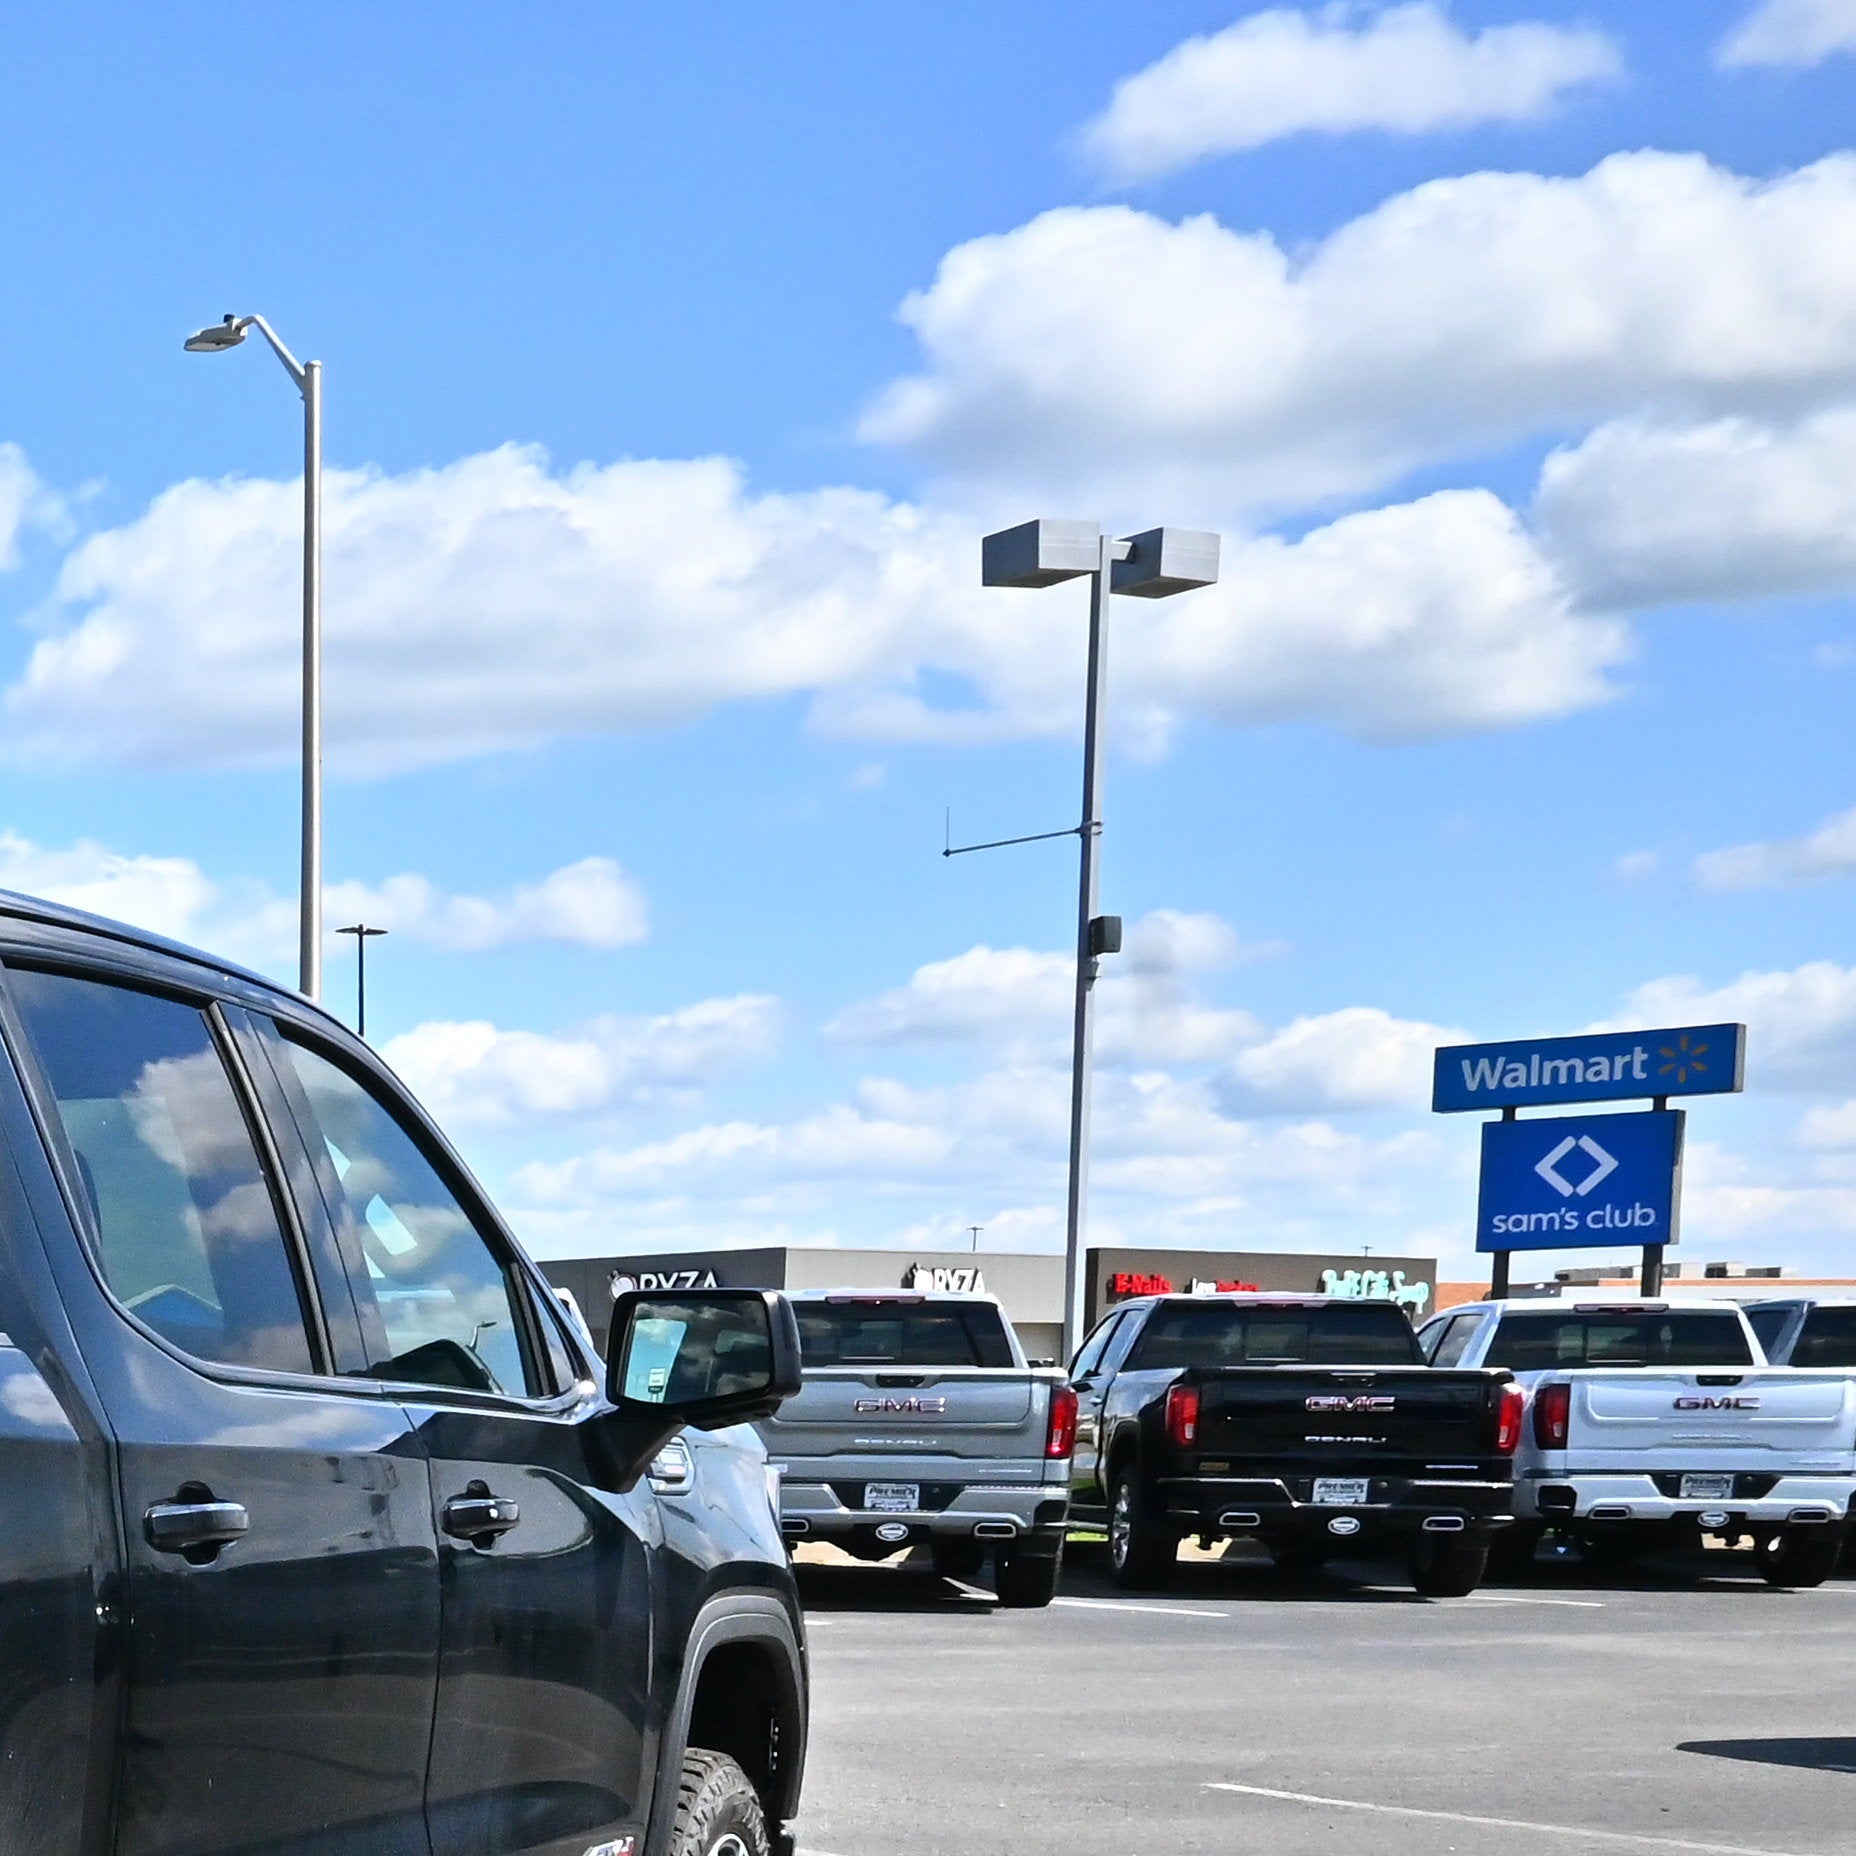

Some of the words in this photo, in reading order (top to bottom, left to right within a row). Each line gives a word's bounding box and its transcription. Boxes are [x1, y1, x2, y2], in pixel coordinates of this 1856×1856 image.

[1461, 1046, 1648, 1091] Walmart
[1492, 1207, 1579, 1233] sam's
[1587, 1202, 1656, 1228] club
[854, 1397, 946, 1412] GMC
[1305, 1396, 1395, 1412] GMC
[1673, 1397, 1762, 1410] GMC
